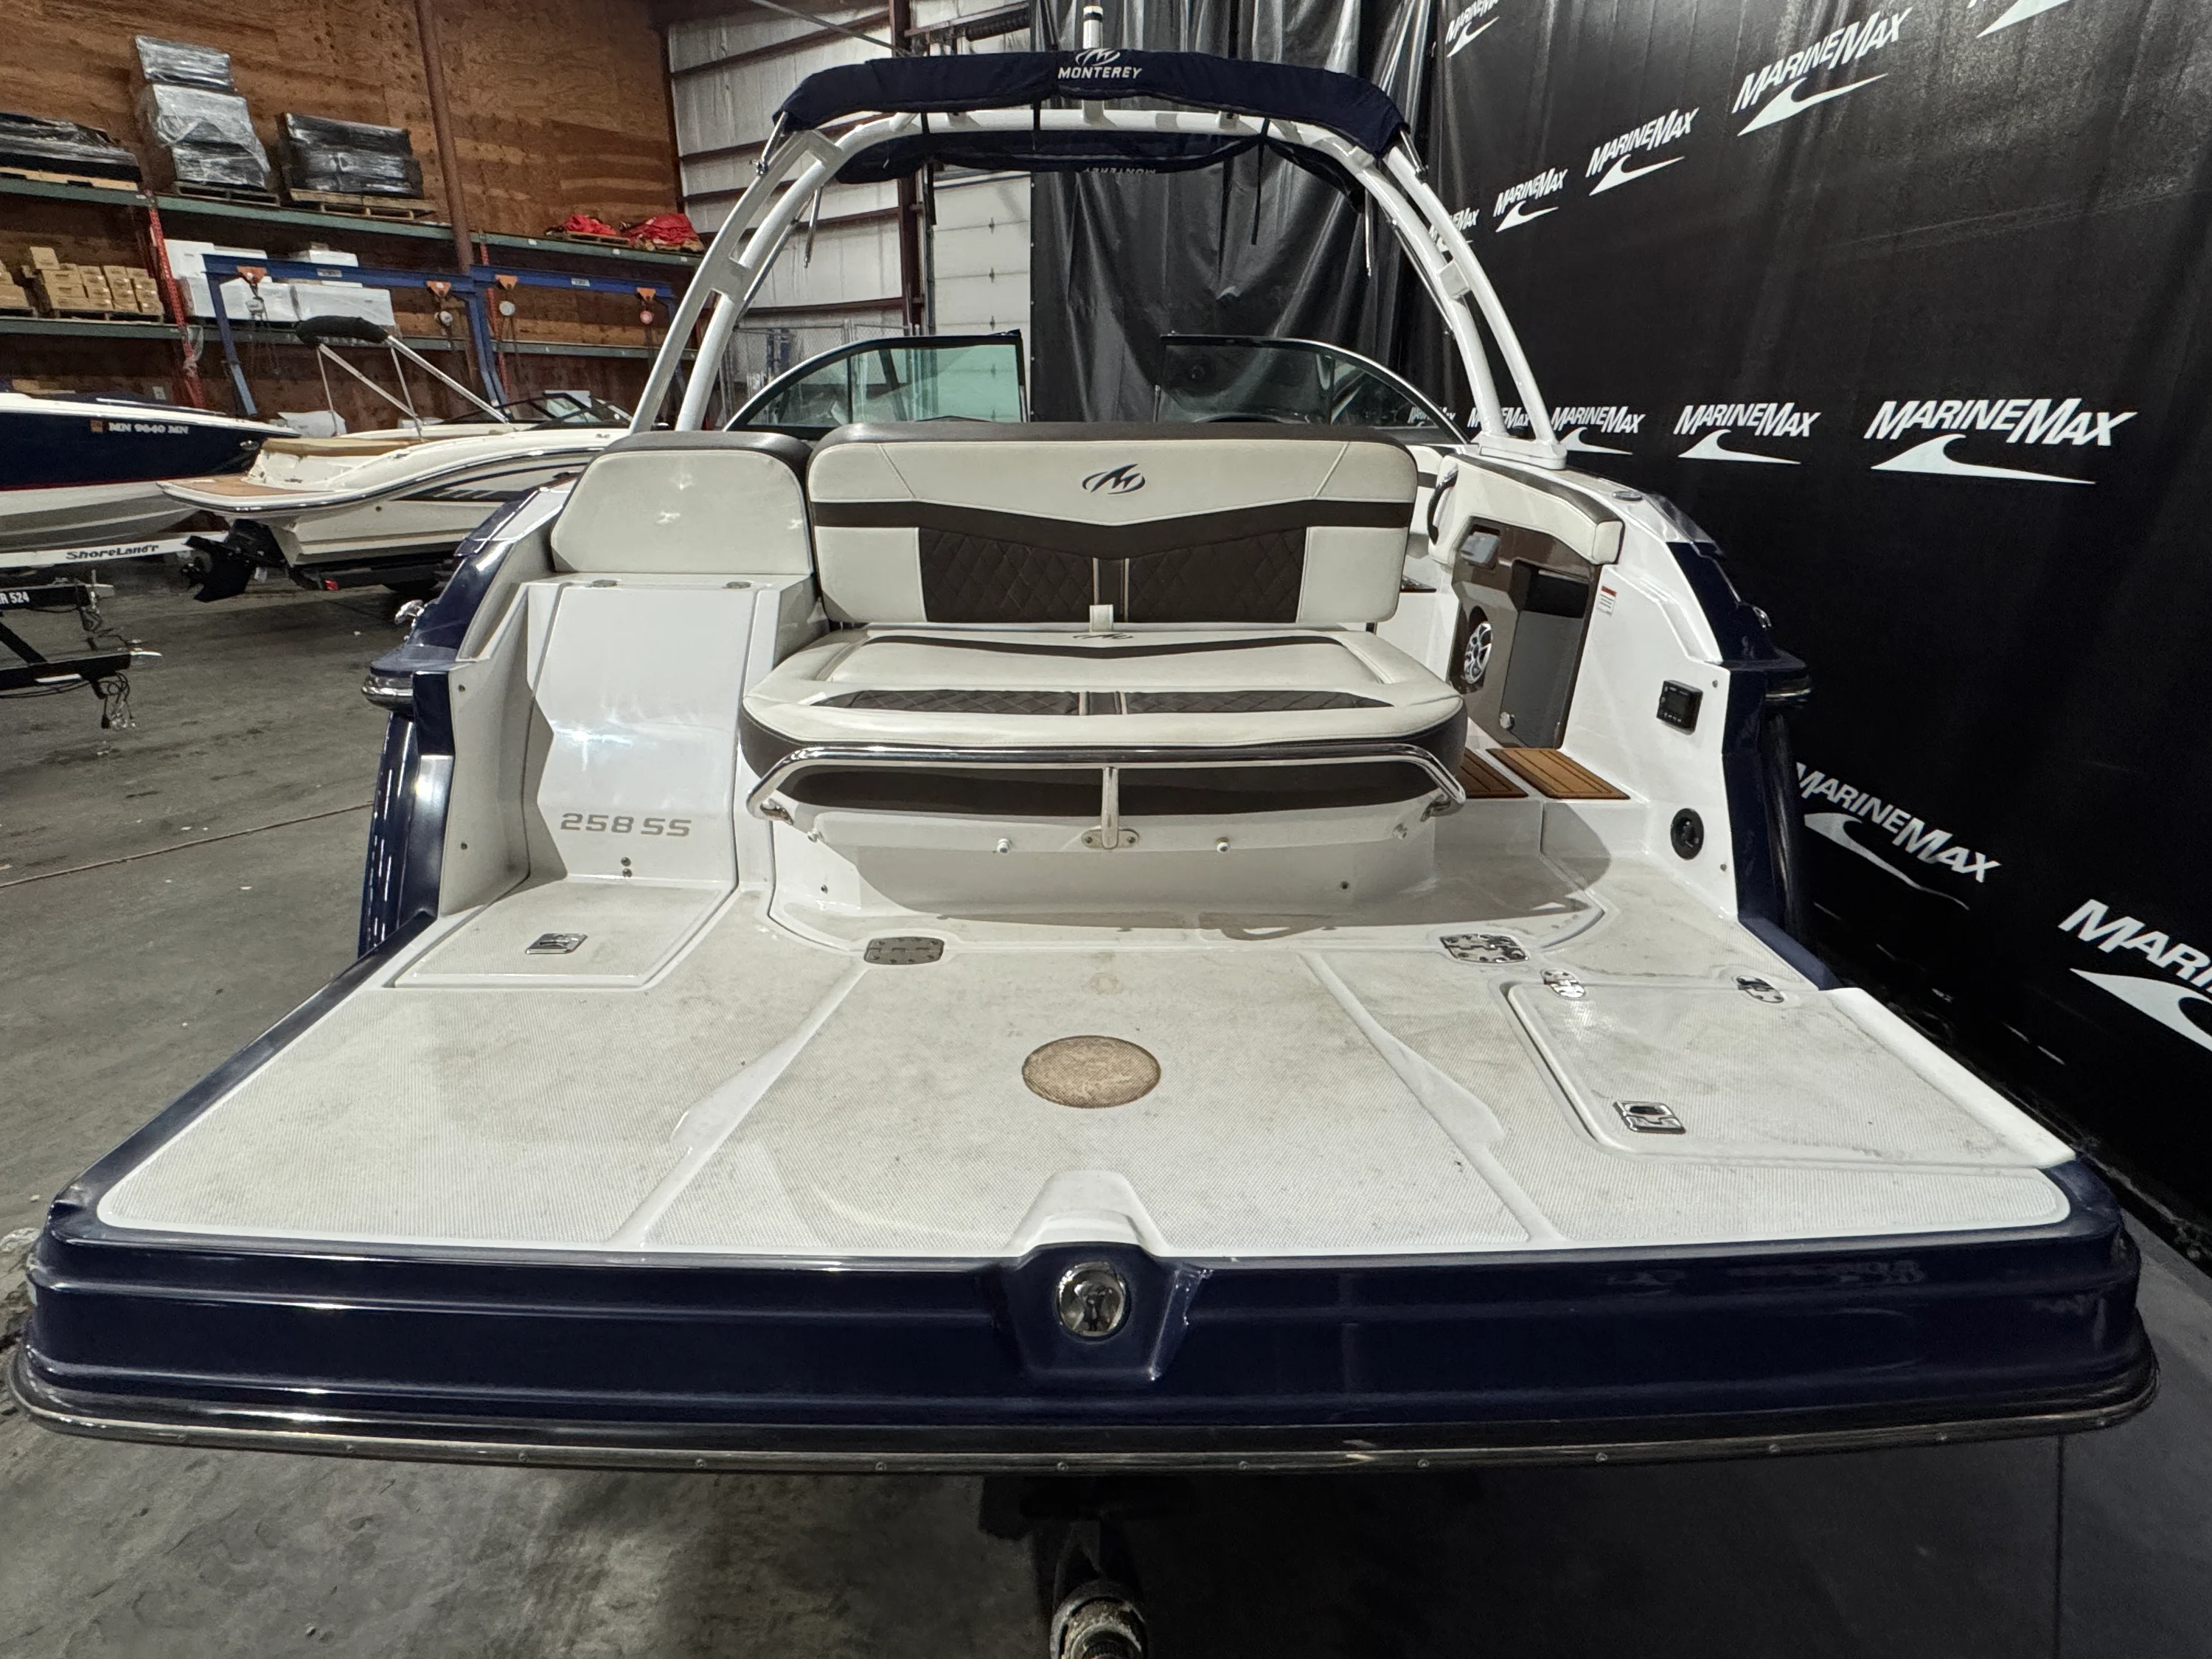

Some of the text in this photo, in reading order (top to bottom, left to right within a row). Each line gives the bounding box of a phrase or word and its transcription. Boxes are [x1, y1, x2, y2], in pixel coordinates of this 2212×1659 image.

[1057, 66, 1143, 80] MONTEREY
[1731, 7, 1913, 114] MARINEMAX
[1585, 107, 1700, 178] MARINEMAX
[1492, 168, 1568, 218] MARINEMAX
[108, 422, 132, 433] MN
[1551, 406, 1646, 434] MARINEMAX
[1673, 402, 1821, 437] MARINEMAX
[1863, 397, 2138, 446] MARINEMAX
[0, 591, 30, 605] R 524
[560, 813, 692, 837] 258 SS
